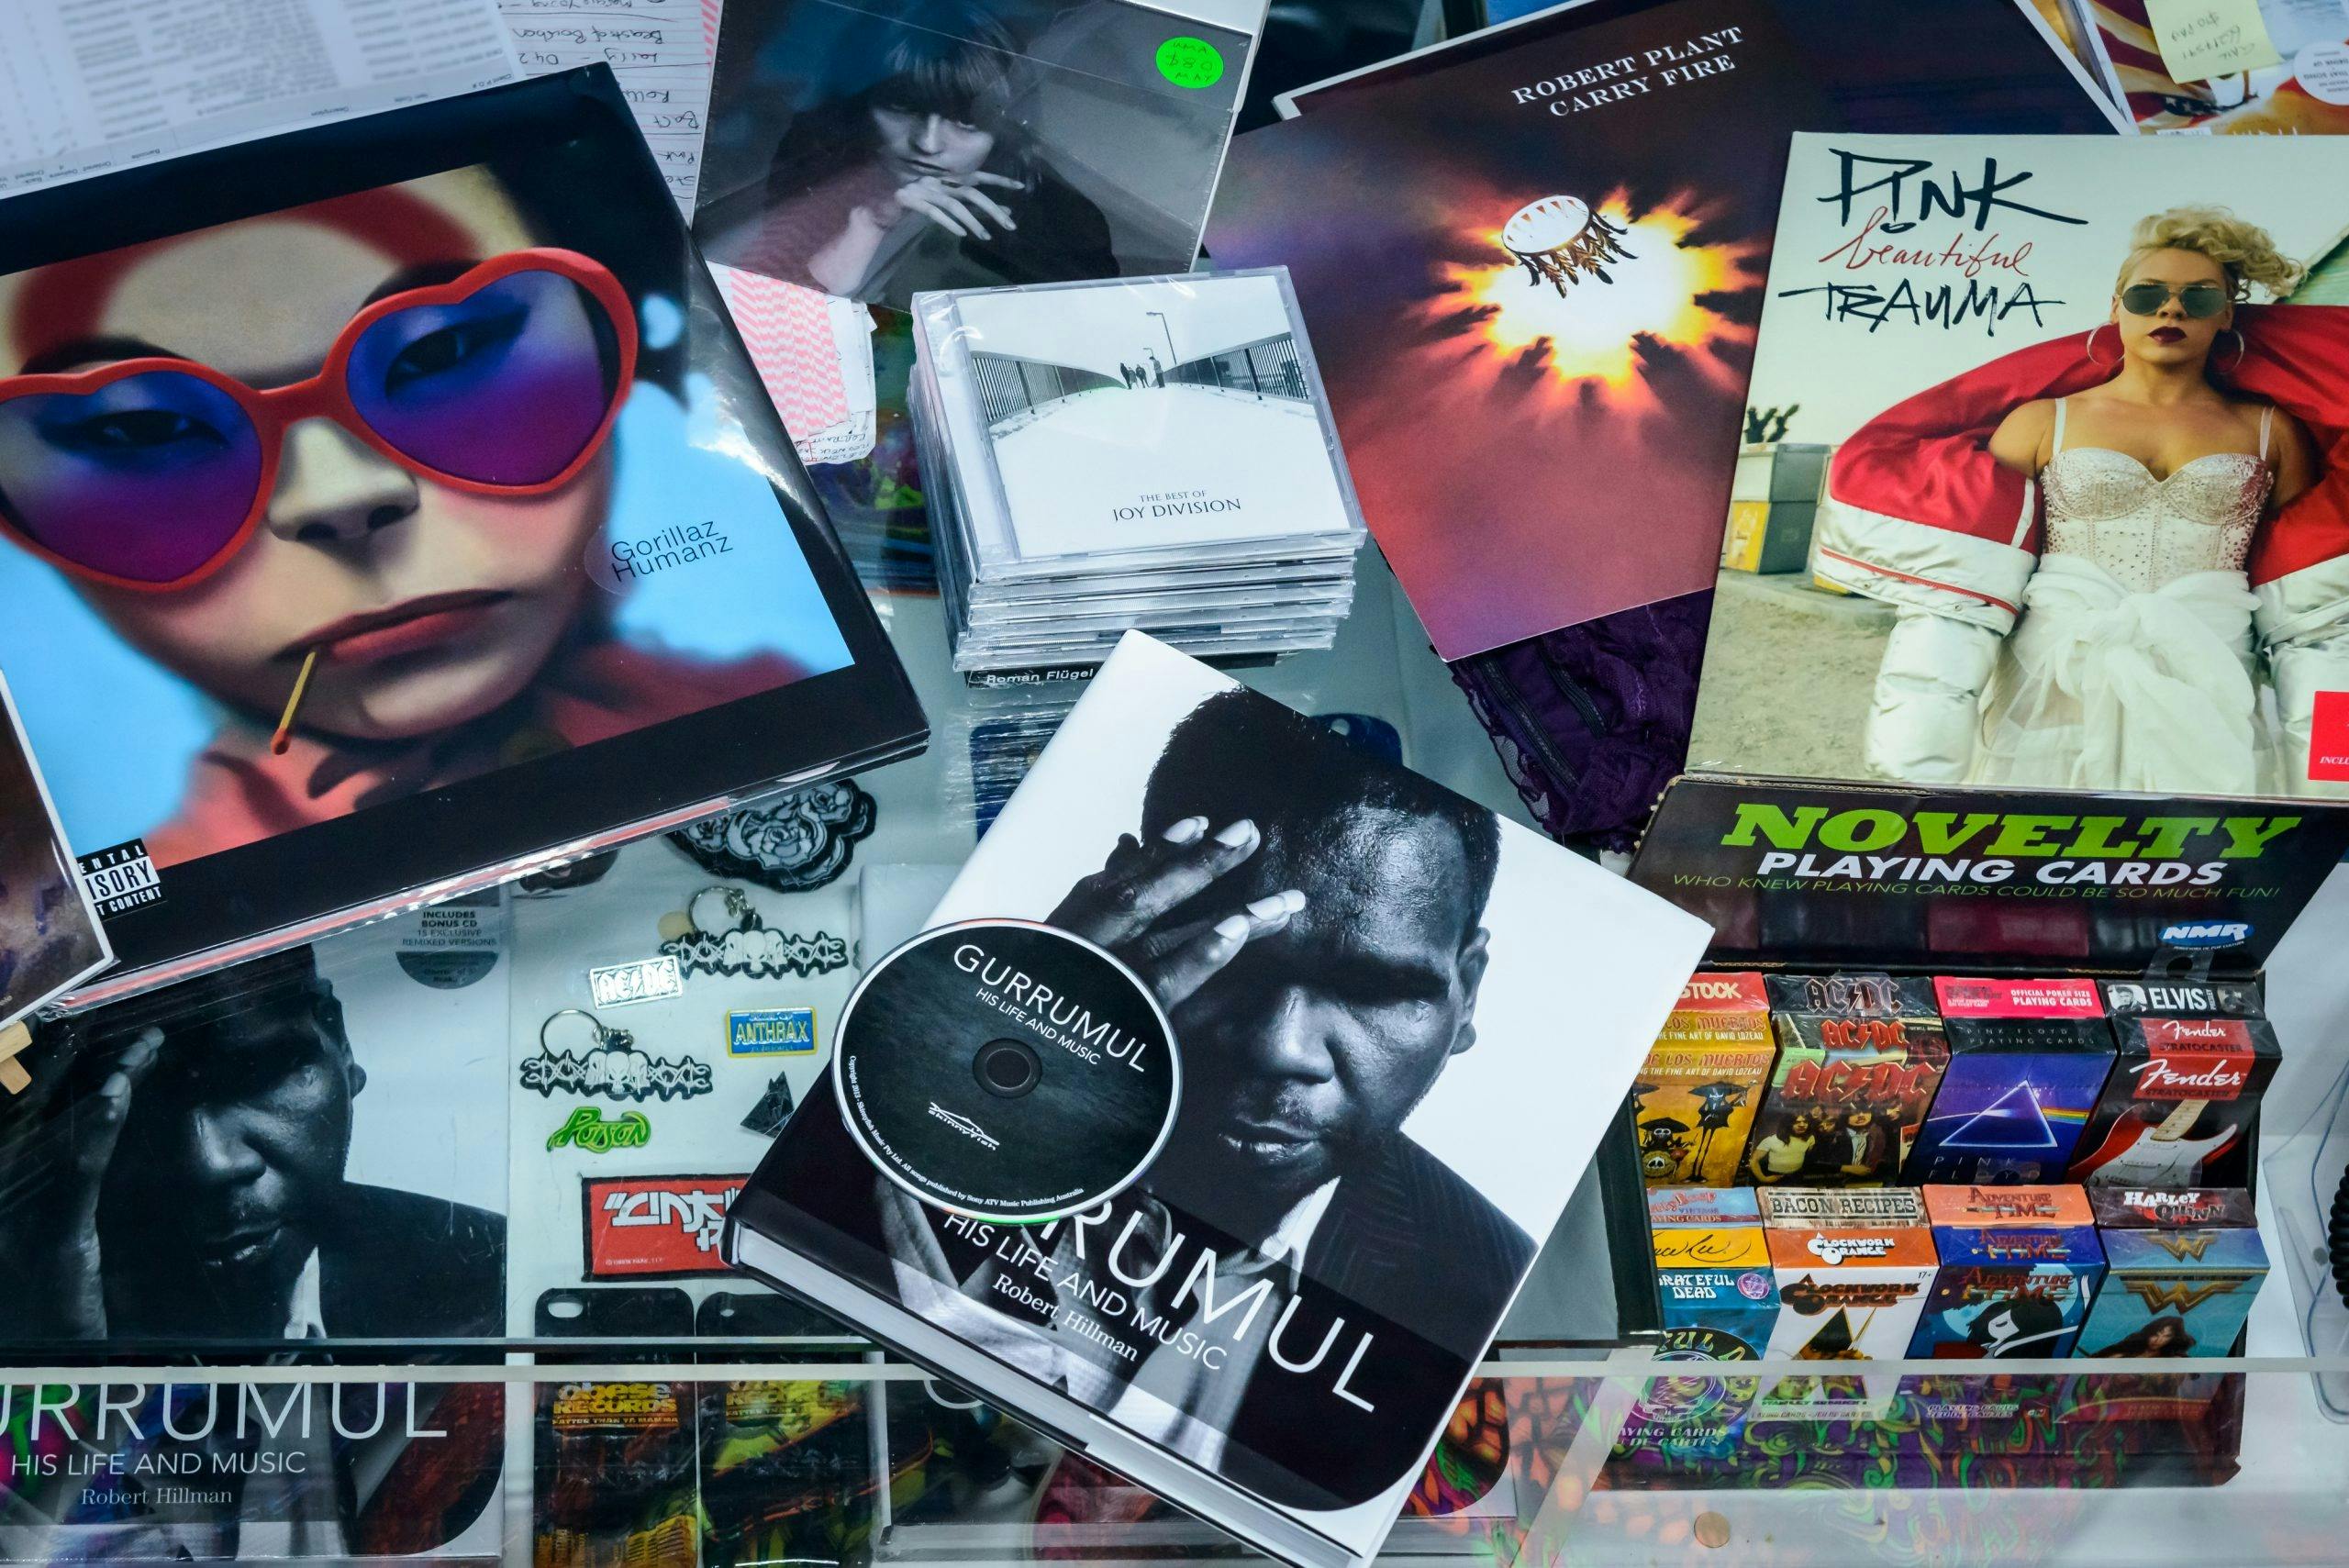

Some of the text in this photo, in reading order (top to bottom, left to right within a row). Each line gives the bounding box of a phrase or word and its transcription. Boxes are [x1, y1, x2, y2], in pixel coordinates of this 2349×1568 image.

[1510, 27, 1743, 105] ROBERT PLANT
[1549, 54, 1736, 117] CARRY FIRE
[1819, 206, 2033, 279] beautiful
[1778, 278, 2066, 337] TRAUMA
[1140, 494, 1163, 503] THE
[1165, 491, 1189, 500] BEST
[1113, 498, 1241, 522] JOY DIVISION
[611, 521, 718, 562] Gorillaz
[611, 537, 733, 583] Humanz
[986, 668, 1094, 684] Roman Flügel
[1720, 803, 2302, 859] NOVELTY
[78, 845, 144, 873] ENTAL
[1756, 852, 2229, 885] PLAYING CARDS
[84, 860, 151, 901] ISORY
[1674, 874, 2281, 899] WHO KNEW PLAYING CARDS COULD BE SO MUCH FUN!
[108, 886, 162, 912] CONTENT
[421, 919, 477, 928] BONUS CD
[423, 910, 476, 918] INCLUDES
[402, 938, 497, 947] REMIXED VERSIONS
[430, 929, 483, 937] EXCLUSIVE
[2163, 923, 2249, 941] NMR
[1680, 982, 1742, 999] STOCK
[2010, 989, 2044, 997] OFFICIAL
[2045, 989, 2072, 997] POKER
[2012, 997, 2093, 1007] PLAYING CARDS
[2148, 987, 2208, 1010] ELVIS
[953, 944, 1146, 1073] GURRUMUL
[734, 1020, 809, 1045] ANTHRAX
[976, 987, 1102, 1065] HIS LIFE AND MUSIC
[1669, 1031, 1687, 1040] FYNE
[1689, 1031, 1703, 1040] ART
[1705, 1031, 1713, 1040] OF
[1715, 1031, 1736, 1040] DAVID
[2162, 1020, 2227, 1040] Fender
[2158, 1042, 2243, 1052] STRATOCASTER
[1665, 1053, 1692, 1066] LOS
[1651, 1068, 1664, 1076] THE
[1666, 1068, 1685, 1076] FYNE
[1686, 1067, 1699, 1075] ART
[1701, 1067, 1709, 1076] OF
[1712, 1067, 1734, 1076] DAVID
[2129, 1059, 2241, 1090] Fender
[901, 1162, 912, 1173] All
[926, 1179, 958, 1197] published
[957, 1192, 966, 1201] by
[967, 1195, 985, 1206] Sony
[984, 1198, 999, 1207] ATV
[999, 1199, 1020, 1207] Music
[1020, 1196, 1057, 1207] Publishing
[1055, 1187, 1085, 1202] Australia
[1968, 1186, 2053, 1203] ADVENTURE
[1771, 1197, 1918, 1214] BACON RECIPES
[1988, 1202, 2055, 1218] TIME
[1961, 1266, 2074, 1286] ADVENTURE
[944, 1213, 1229, 1371] HIS LIFE AND MUSIC
[1673, 1286, 1718, 1299] DEAD
[992, 1273, 1139, 1362] Robert Hillman
[1041, 1199, 1375, 1413] RUMUL
[0, 1376, 448, 1441] RRUMUL
[553, 1399, 678, 1414] RECORDS
[1620, 1428, 1665, 1437] AYING
[11, 1451, 306, 1476] HIS LIFE AND MUSIC
[82, 1486, 233, 1506] Robert Hillman
